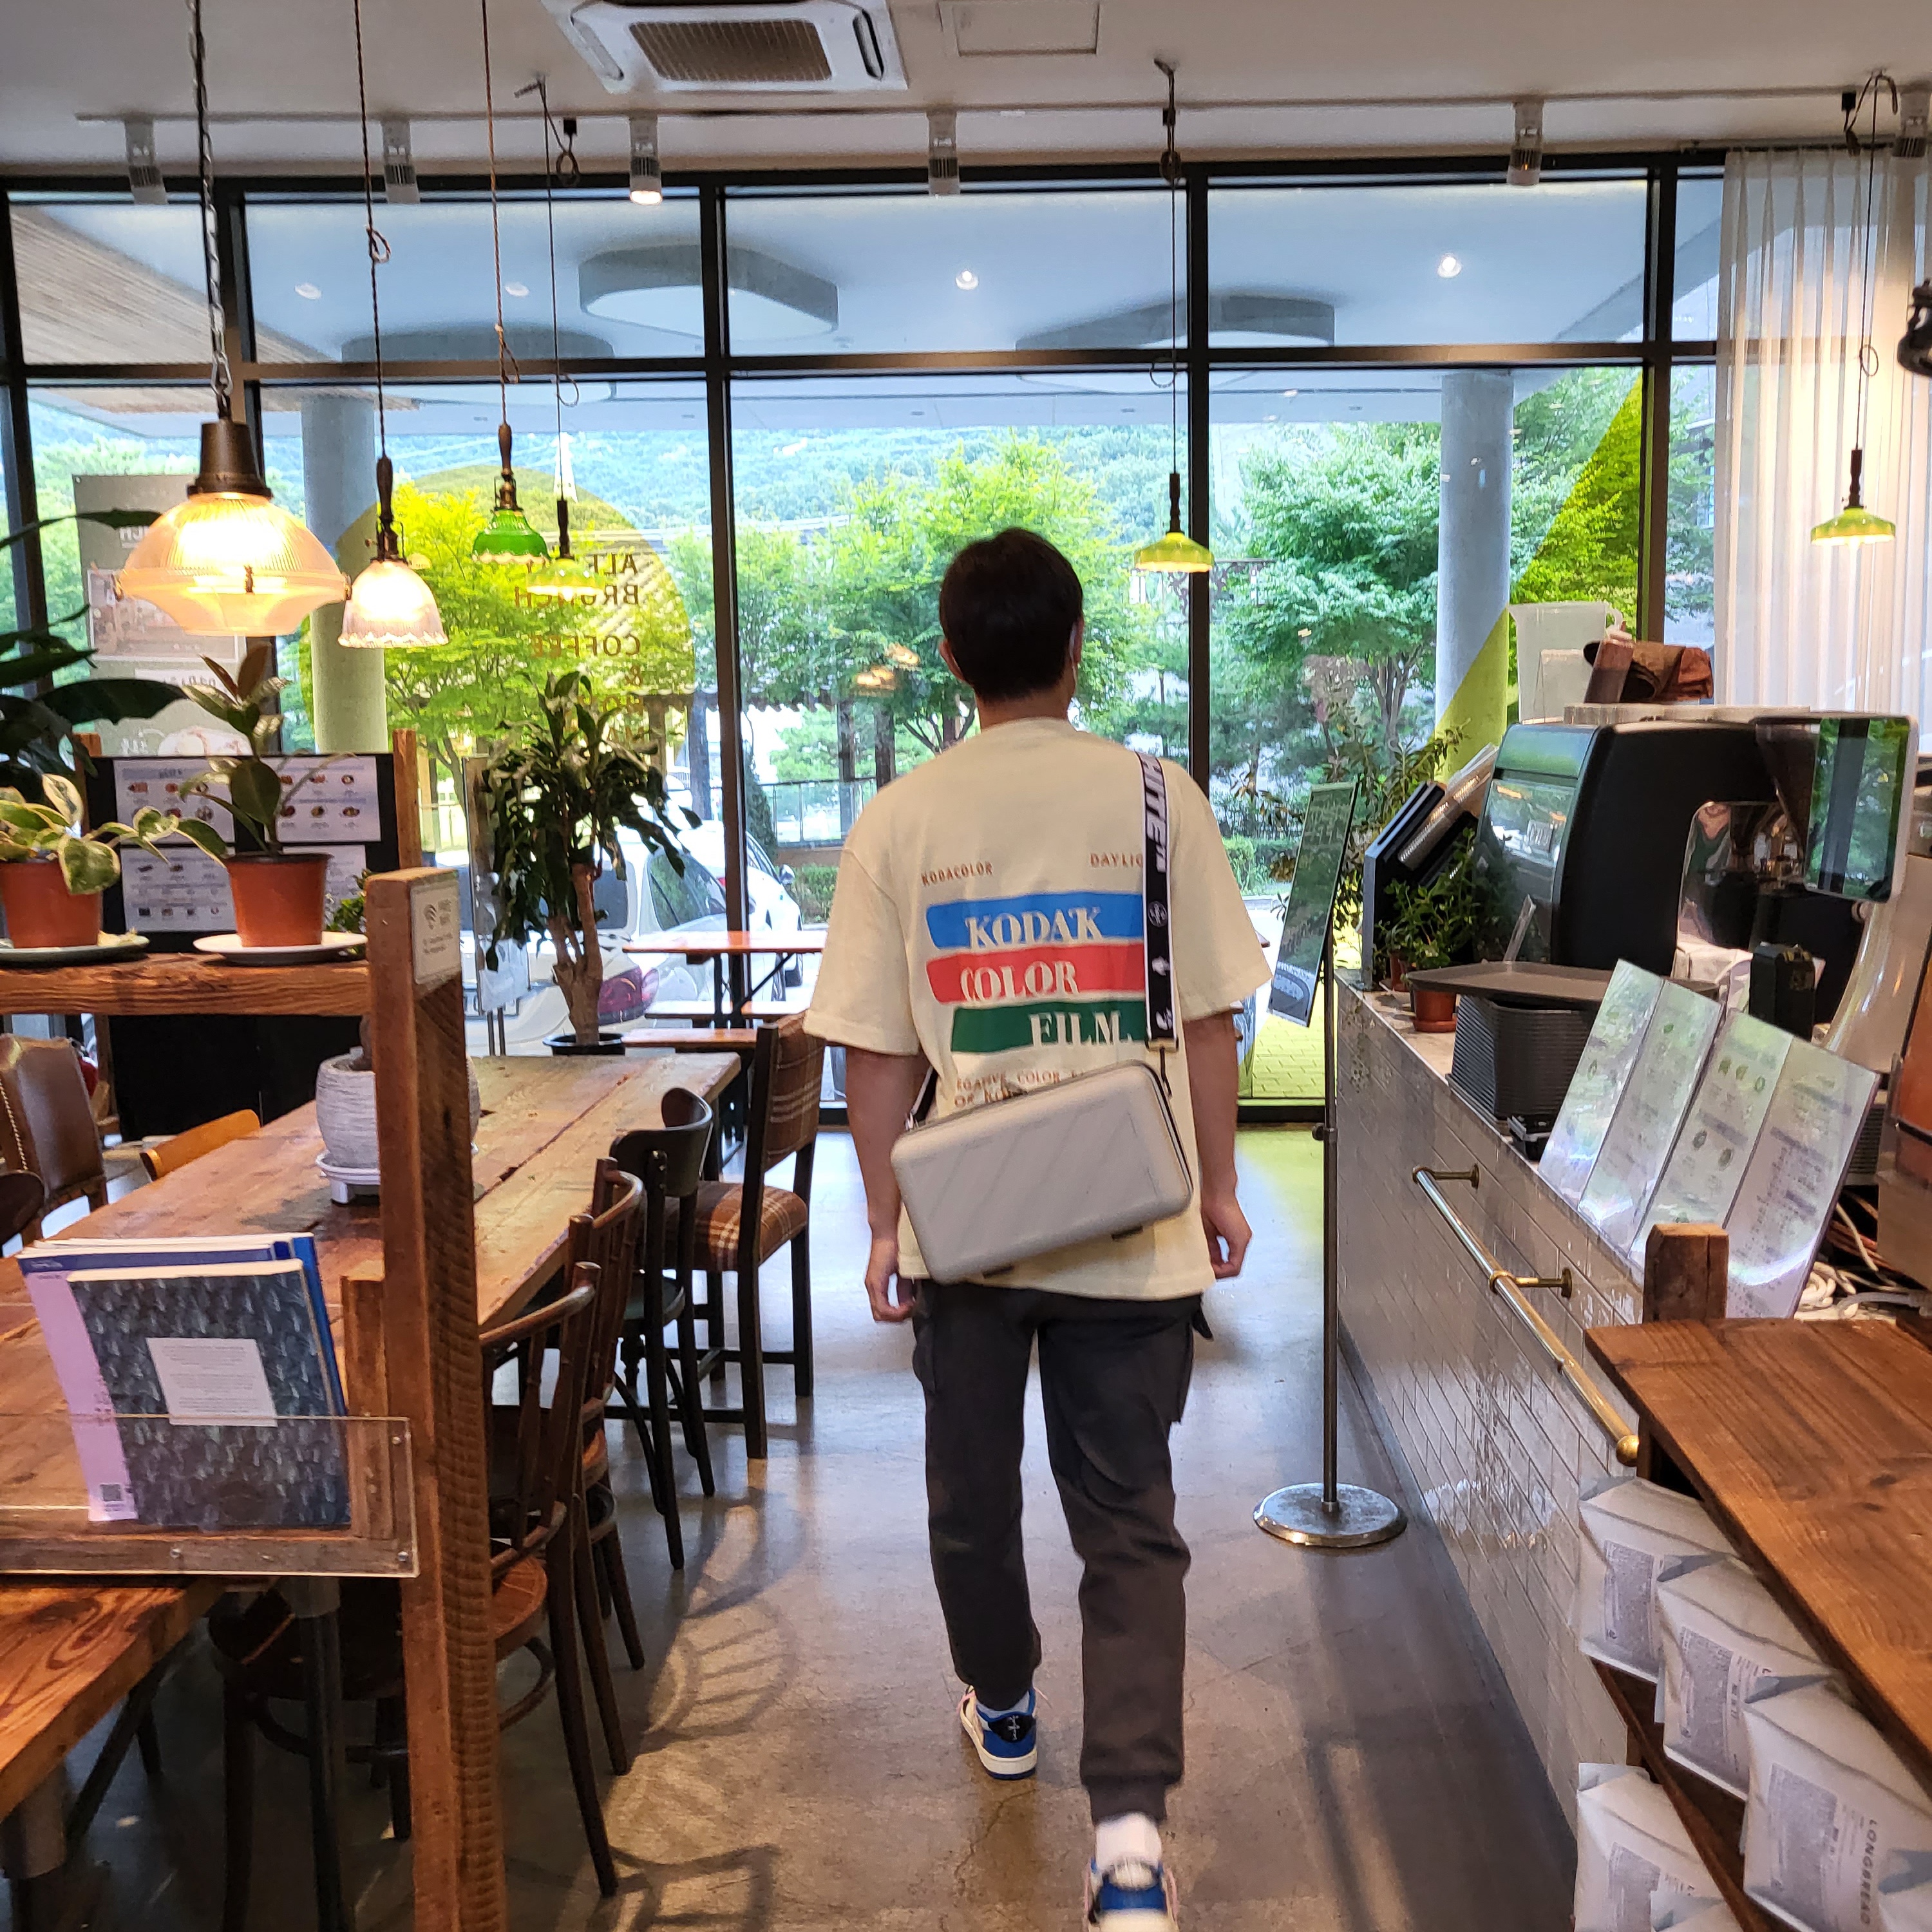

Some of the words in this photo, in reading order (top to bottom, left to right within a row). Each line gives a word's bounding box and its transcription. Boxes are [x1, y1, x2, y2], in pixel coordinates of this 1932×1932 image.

[921, 860, 993, 887] KODACOLOR
[965, 906, 1102, 951] KODAK
[960, 960, 1080, 1001] COLOR
